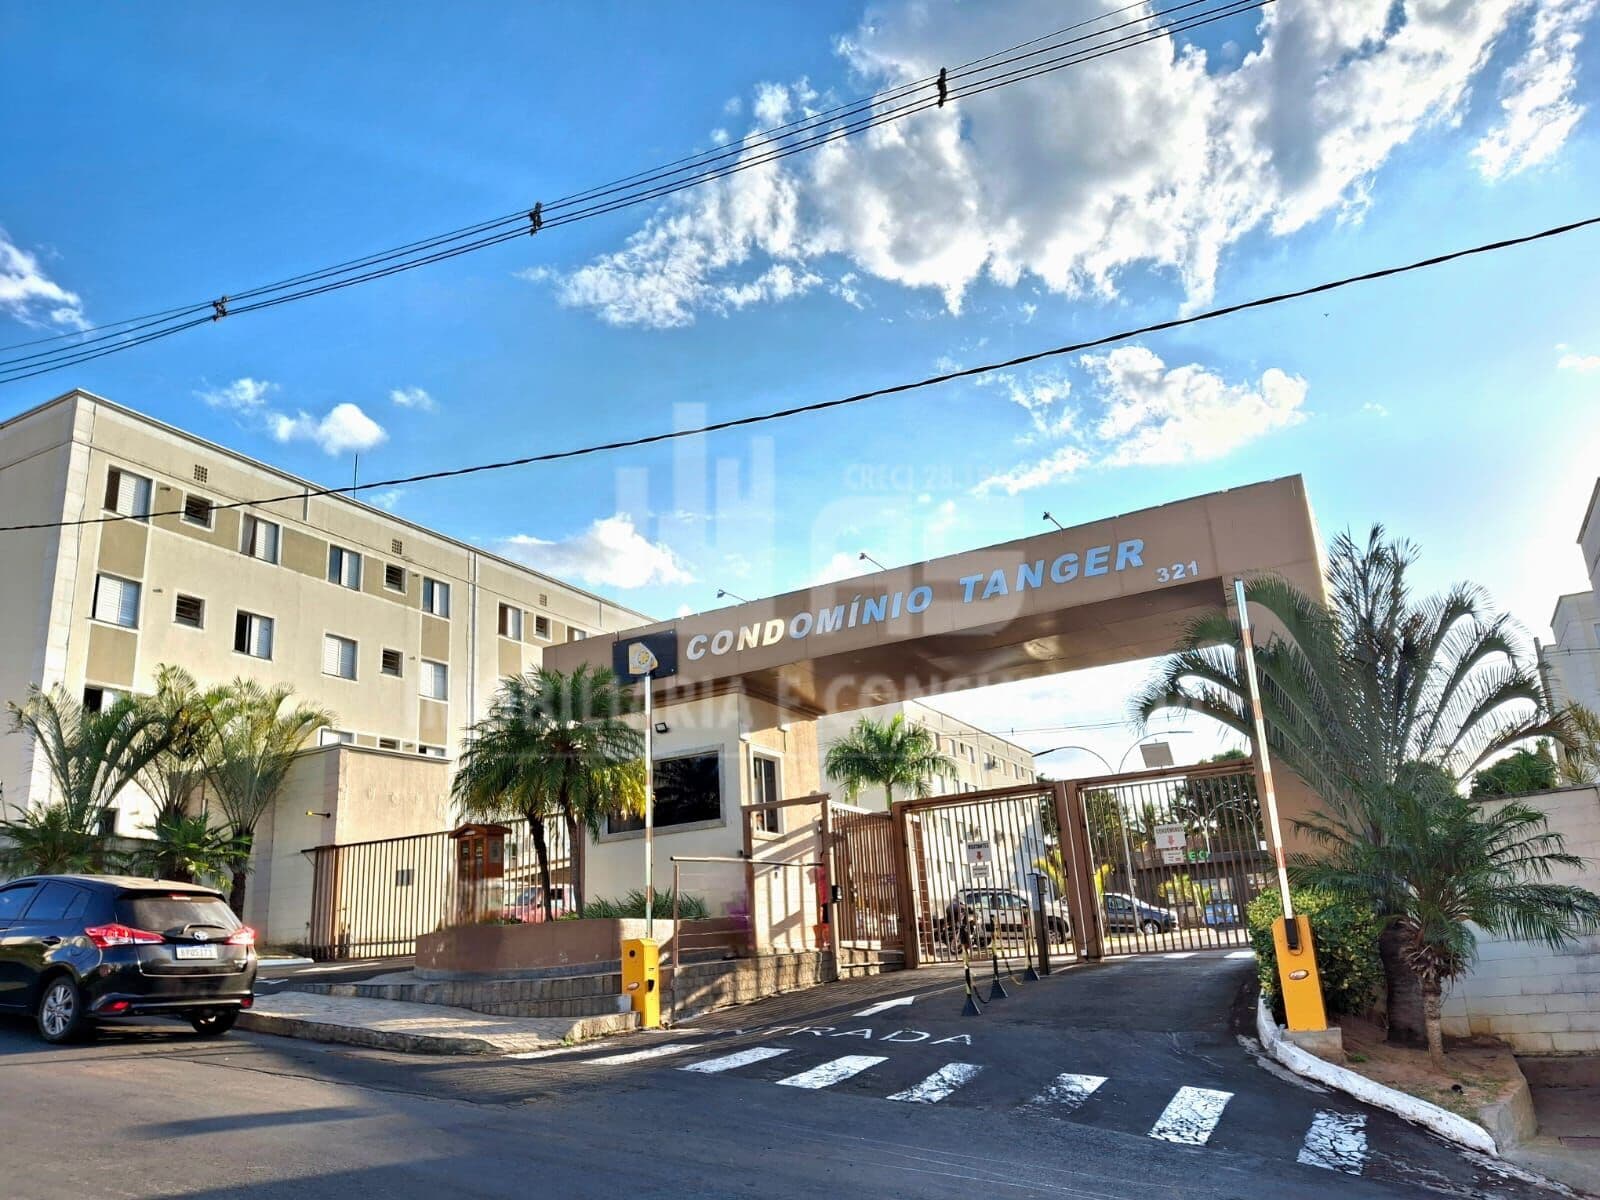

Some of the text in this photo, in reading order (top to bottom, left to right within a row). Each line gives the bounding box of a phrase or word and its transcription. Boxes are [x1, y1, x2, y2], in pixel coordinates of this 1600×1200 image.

[686, 538, 1145, 661] CONDOMÍNIO TANGER
[1156, 560, 1200, 583] 321
